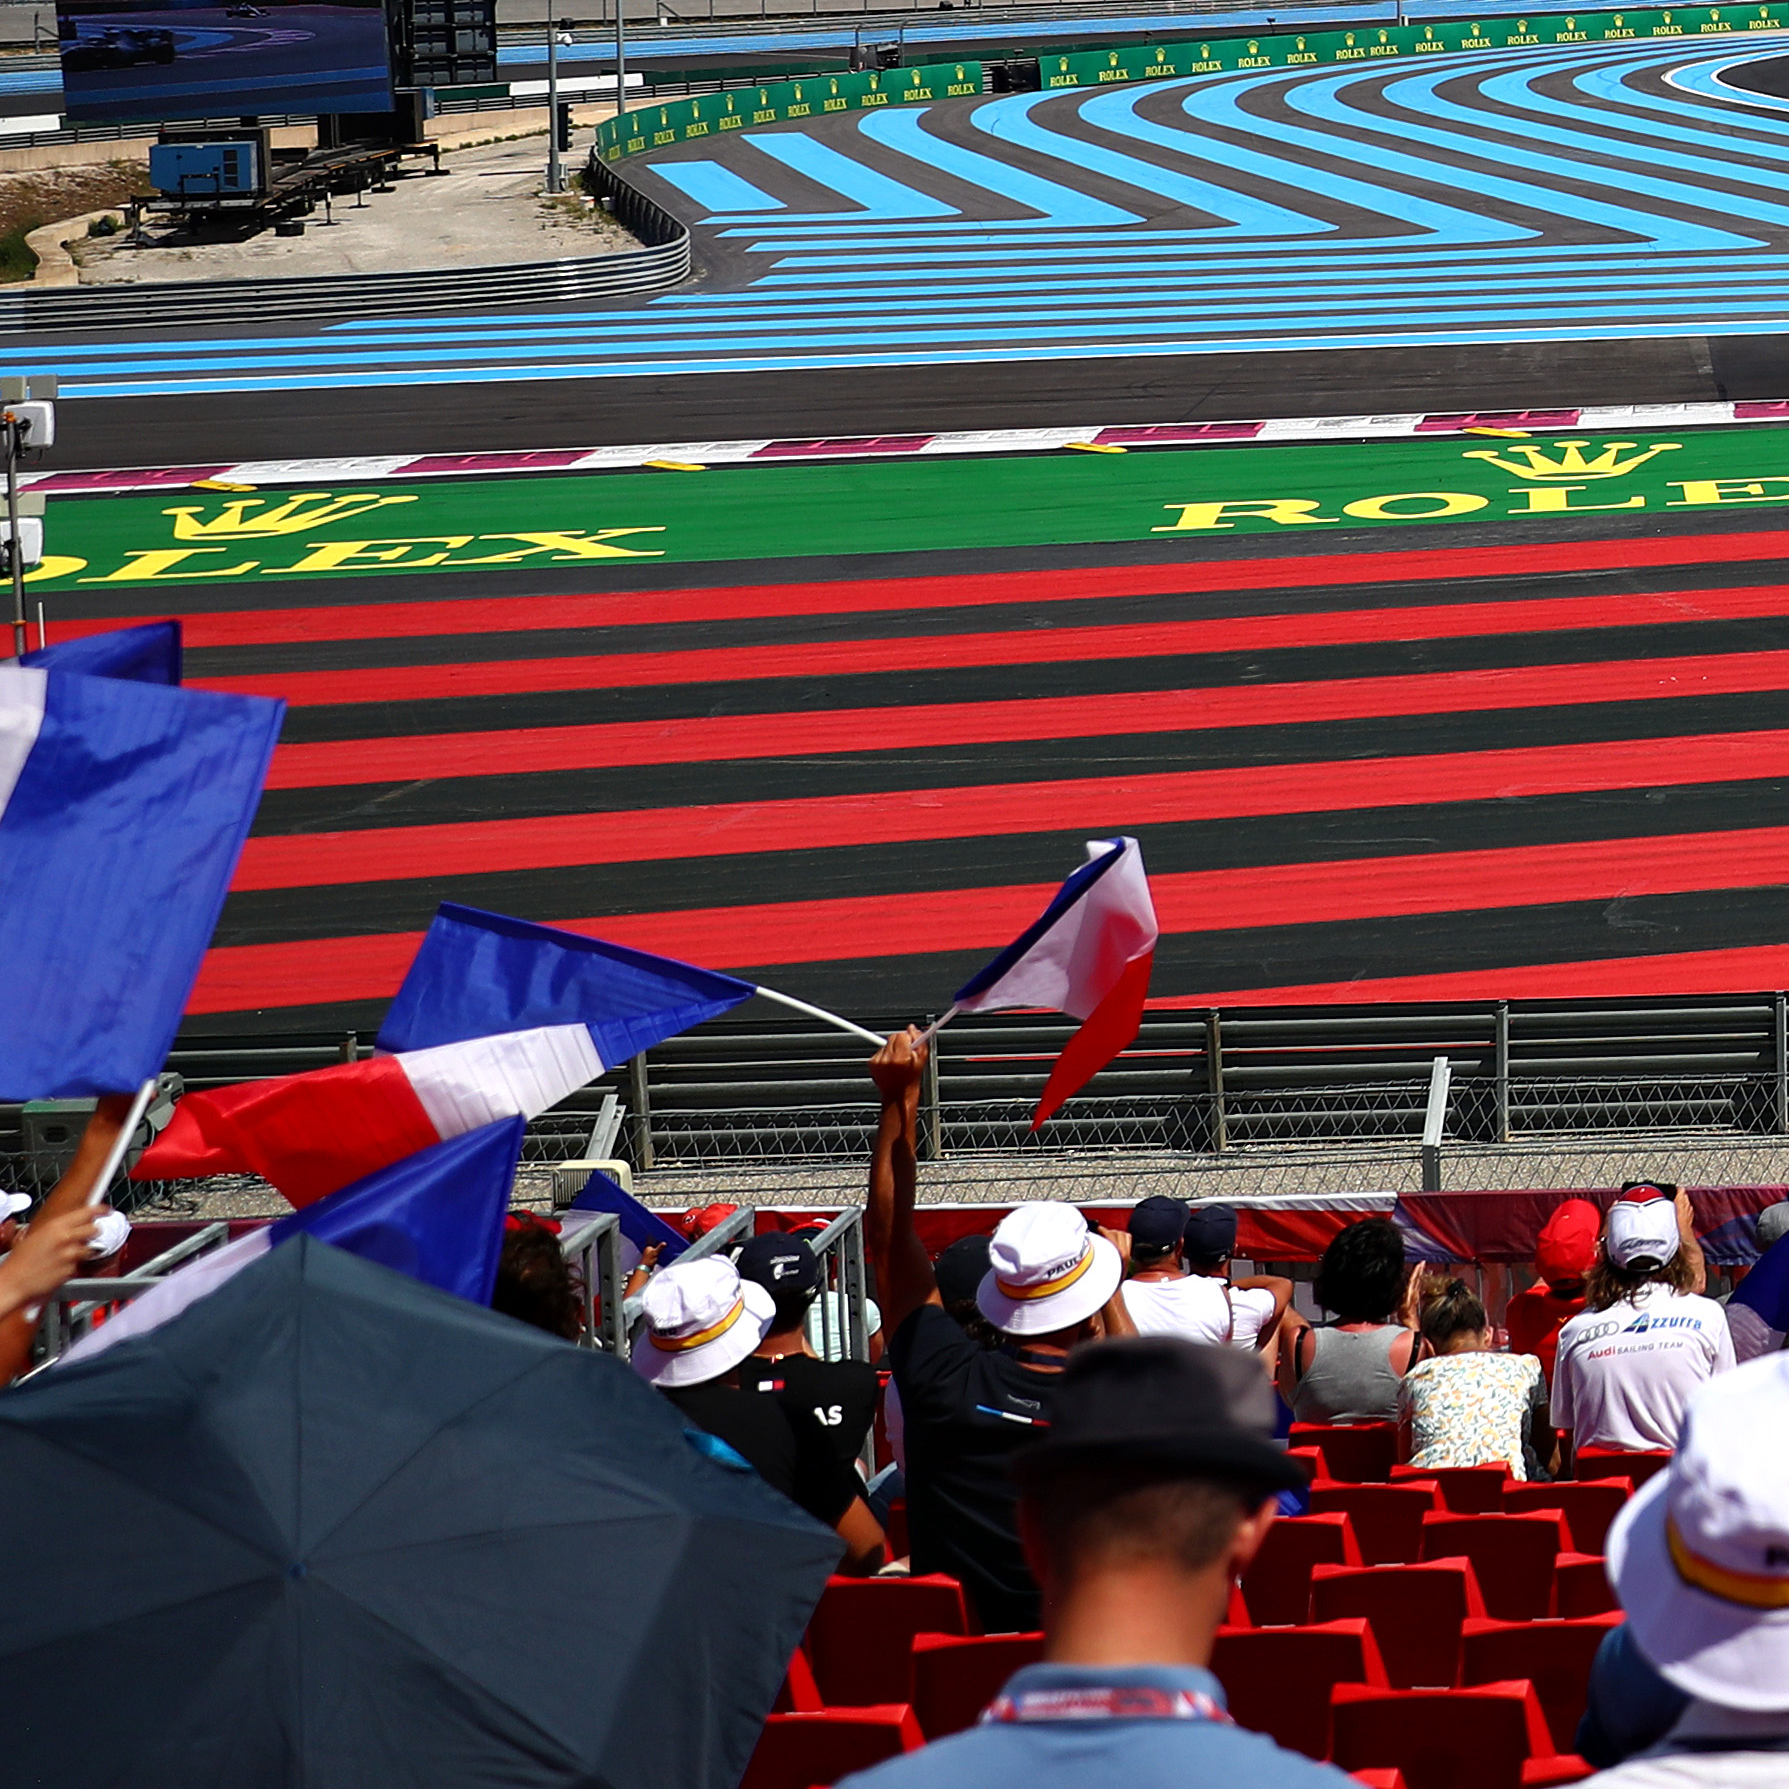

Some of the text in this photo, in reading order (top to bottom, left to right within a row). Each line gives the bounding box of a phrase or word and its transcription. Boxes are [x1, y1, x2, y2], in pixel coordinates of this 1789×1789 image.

[861, 93, 888, 106] ROLEX
[904, 88, 932, 101] ROLEX
[947, 83, 976, 96] ROLEX
[1050, 74, 1078, 87] ROLEX
[1099, 68, 1129, 82] ROLEX
[1145, 64, 1176, 77] ROLEX
[1192, 60, 1222, 72] ROLEX
[1238, 56, 1271, 68] ROLEX
[1287, 52, 1317, 64] ROLEX
[1335, 47, 1366, 59] ROLEX
[1370, 45, 1398, 56] ROLEX
[1415, 40, 1444, 52] ROLEX
[1461, 37, 1491, 49] ROLEX
[1507, 33, 1539, 45] ROLEX
[1556, 30, 1587, 42] ROLEX
[1604, 27, 1635, 38] ROLEX
[1652, 24, 1683, 36] ROLEX
[1701, 21, 1731, 33] ROLEX
[1749, 18, 1780, 30] ROLEX
[1588, 1341, 1683, 1360] Audi SAILING TEAM
